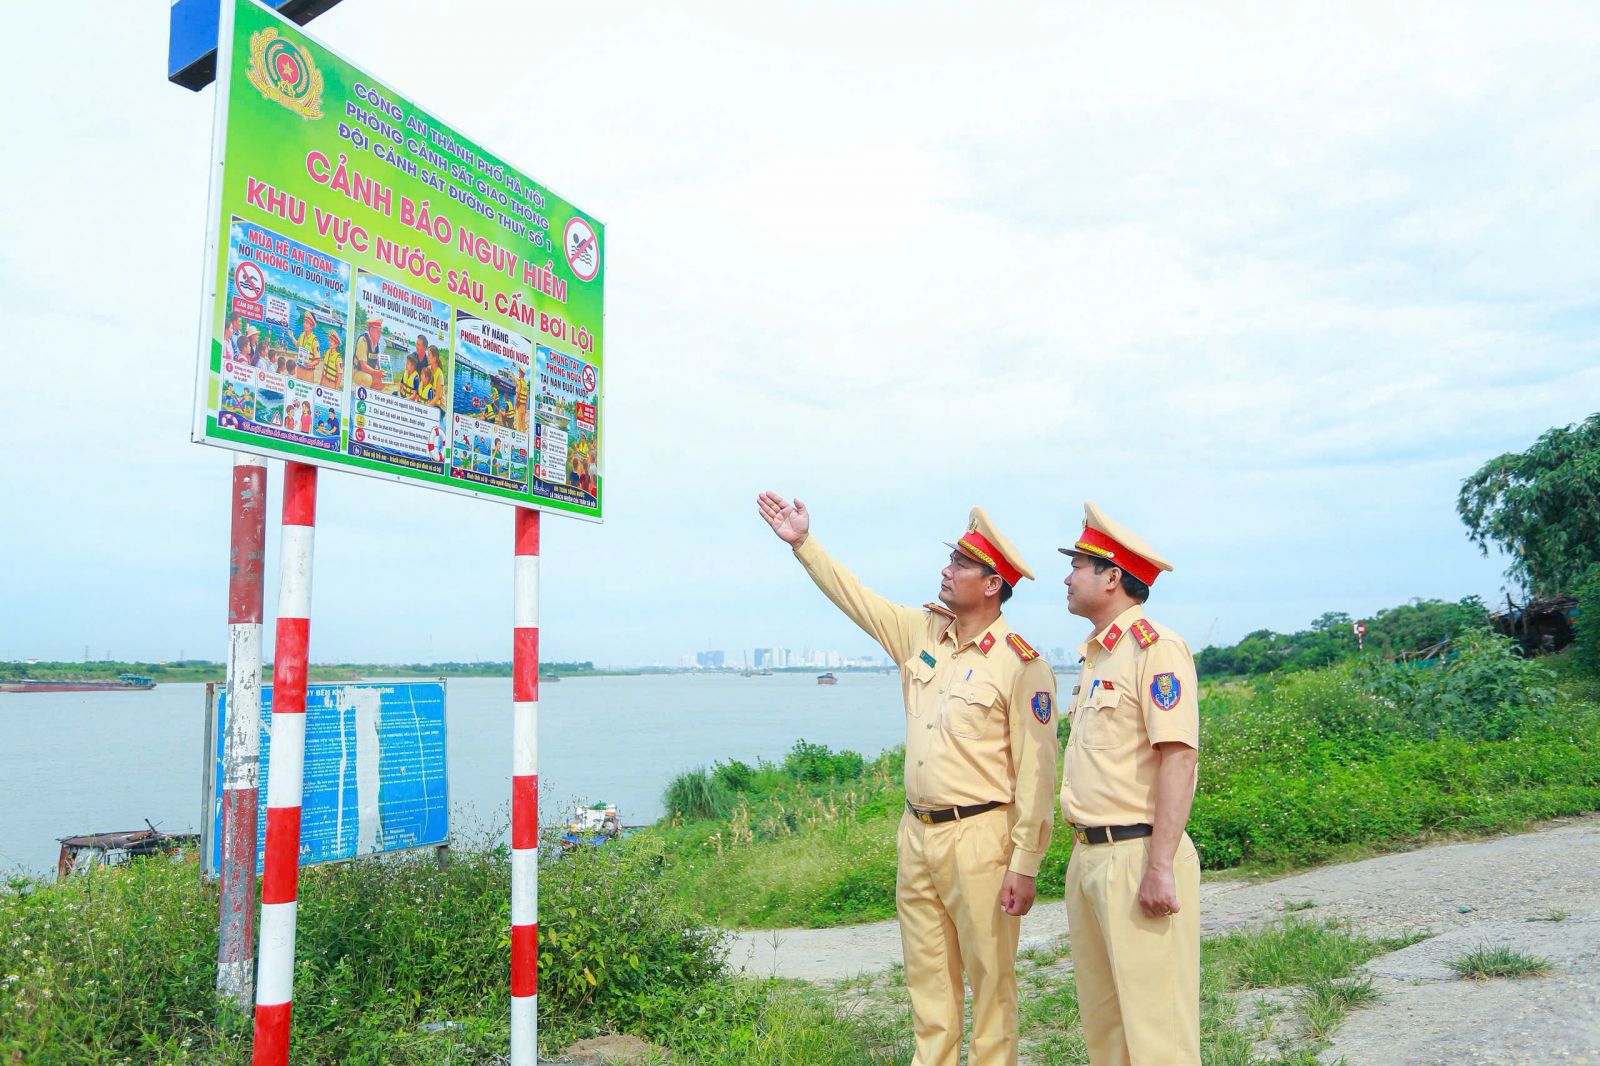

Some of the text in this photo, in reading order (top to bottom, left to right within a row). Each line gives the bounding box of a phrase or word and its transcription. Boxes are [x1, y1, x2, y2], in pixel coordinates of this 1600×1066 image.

[338, 122, 370, 151] ĐỘI
[373, 143, 418, 178] CẢNH
[421, 168, 445, 192] SÁT
[448, 184, 494, 220] ĐƯỜNG
[528, 231, 544, 248] SỐ
[546, 240, 552, 252] 1
[346, 101, 549, 230] PHÒNG CẢNH SÁT GIAO THÔNG
[354, 82, 545, 209] CÔNG AN THÀNH PHỐ HÀ NỘI
[247, 176, 594, 354] KHU VỰC NƯỚC SÂU, CẤM BƠI LỘI
[249, 229, 272, 250] MÙA
[291, 248, 305, 264] AN
[307, 253, 332, 274] TOÀN
[256, 250, 288, 272] KHÔNG
[306, 151, 567, 303] CẢNH BÁO NGUY HIỂM
[363, 290, 372, 302] TAI
[419, 312, 429, 325] CHO
[441, 321, 449, 331] EM
[382, 282, 409, 302] PHÒNG
